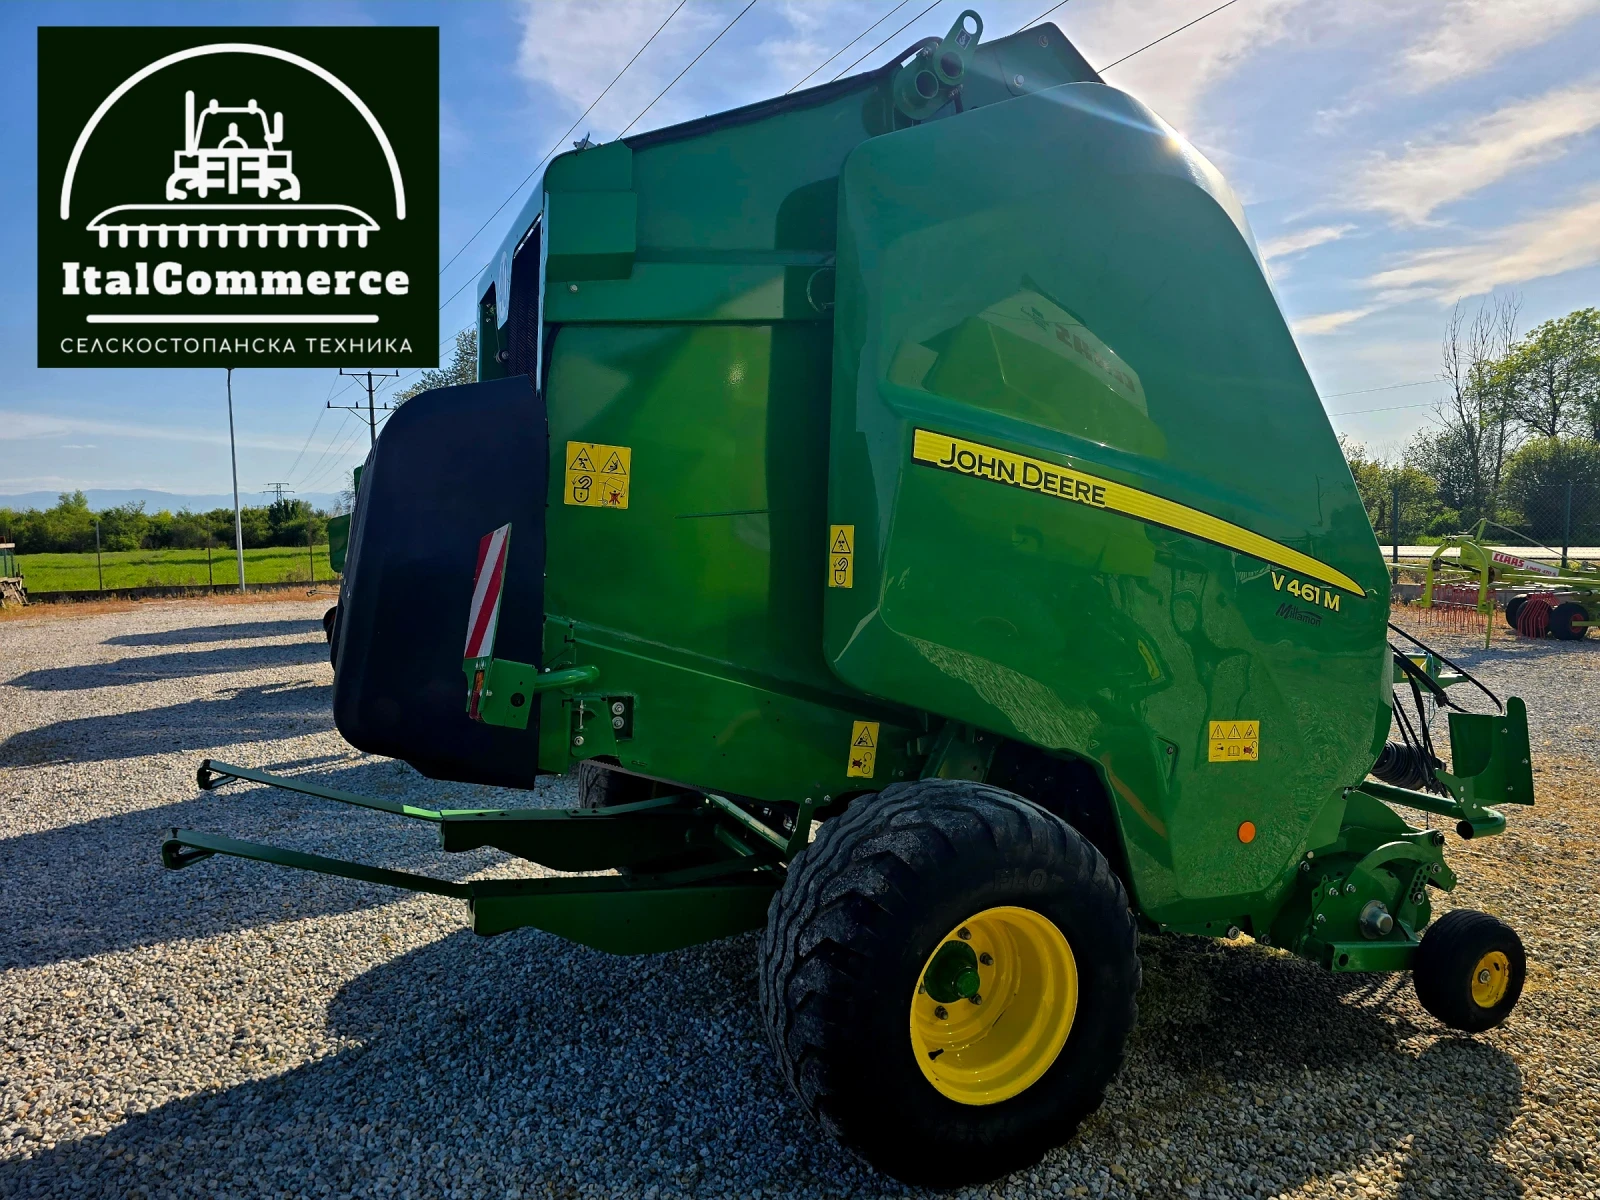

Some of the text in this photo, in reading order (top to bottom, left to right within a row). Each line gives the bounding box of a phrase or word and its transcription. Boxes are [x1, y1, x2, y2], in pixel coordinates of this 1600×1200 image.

[939, 443, 1106, 506] JOHN DEERE
[1493, 552, 1525, 568] CLAAS
[1270, 571, 1340, 613] V 461 M
[1275, 602, 1322, 627] Millamon
